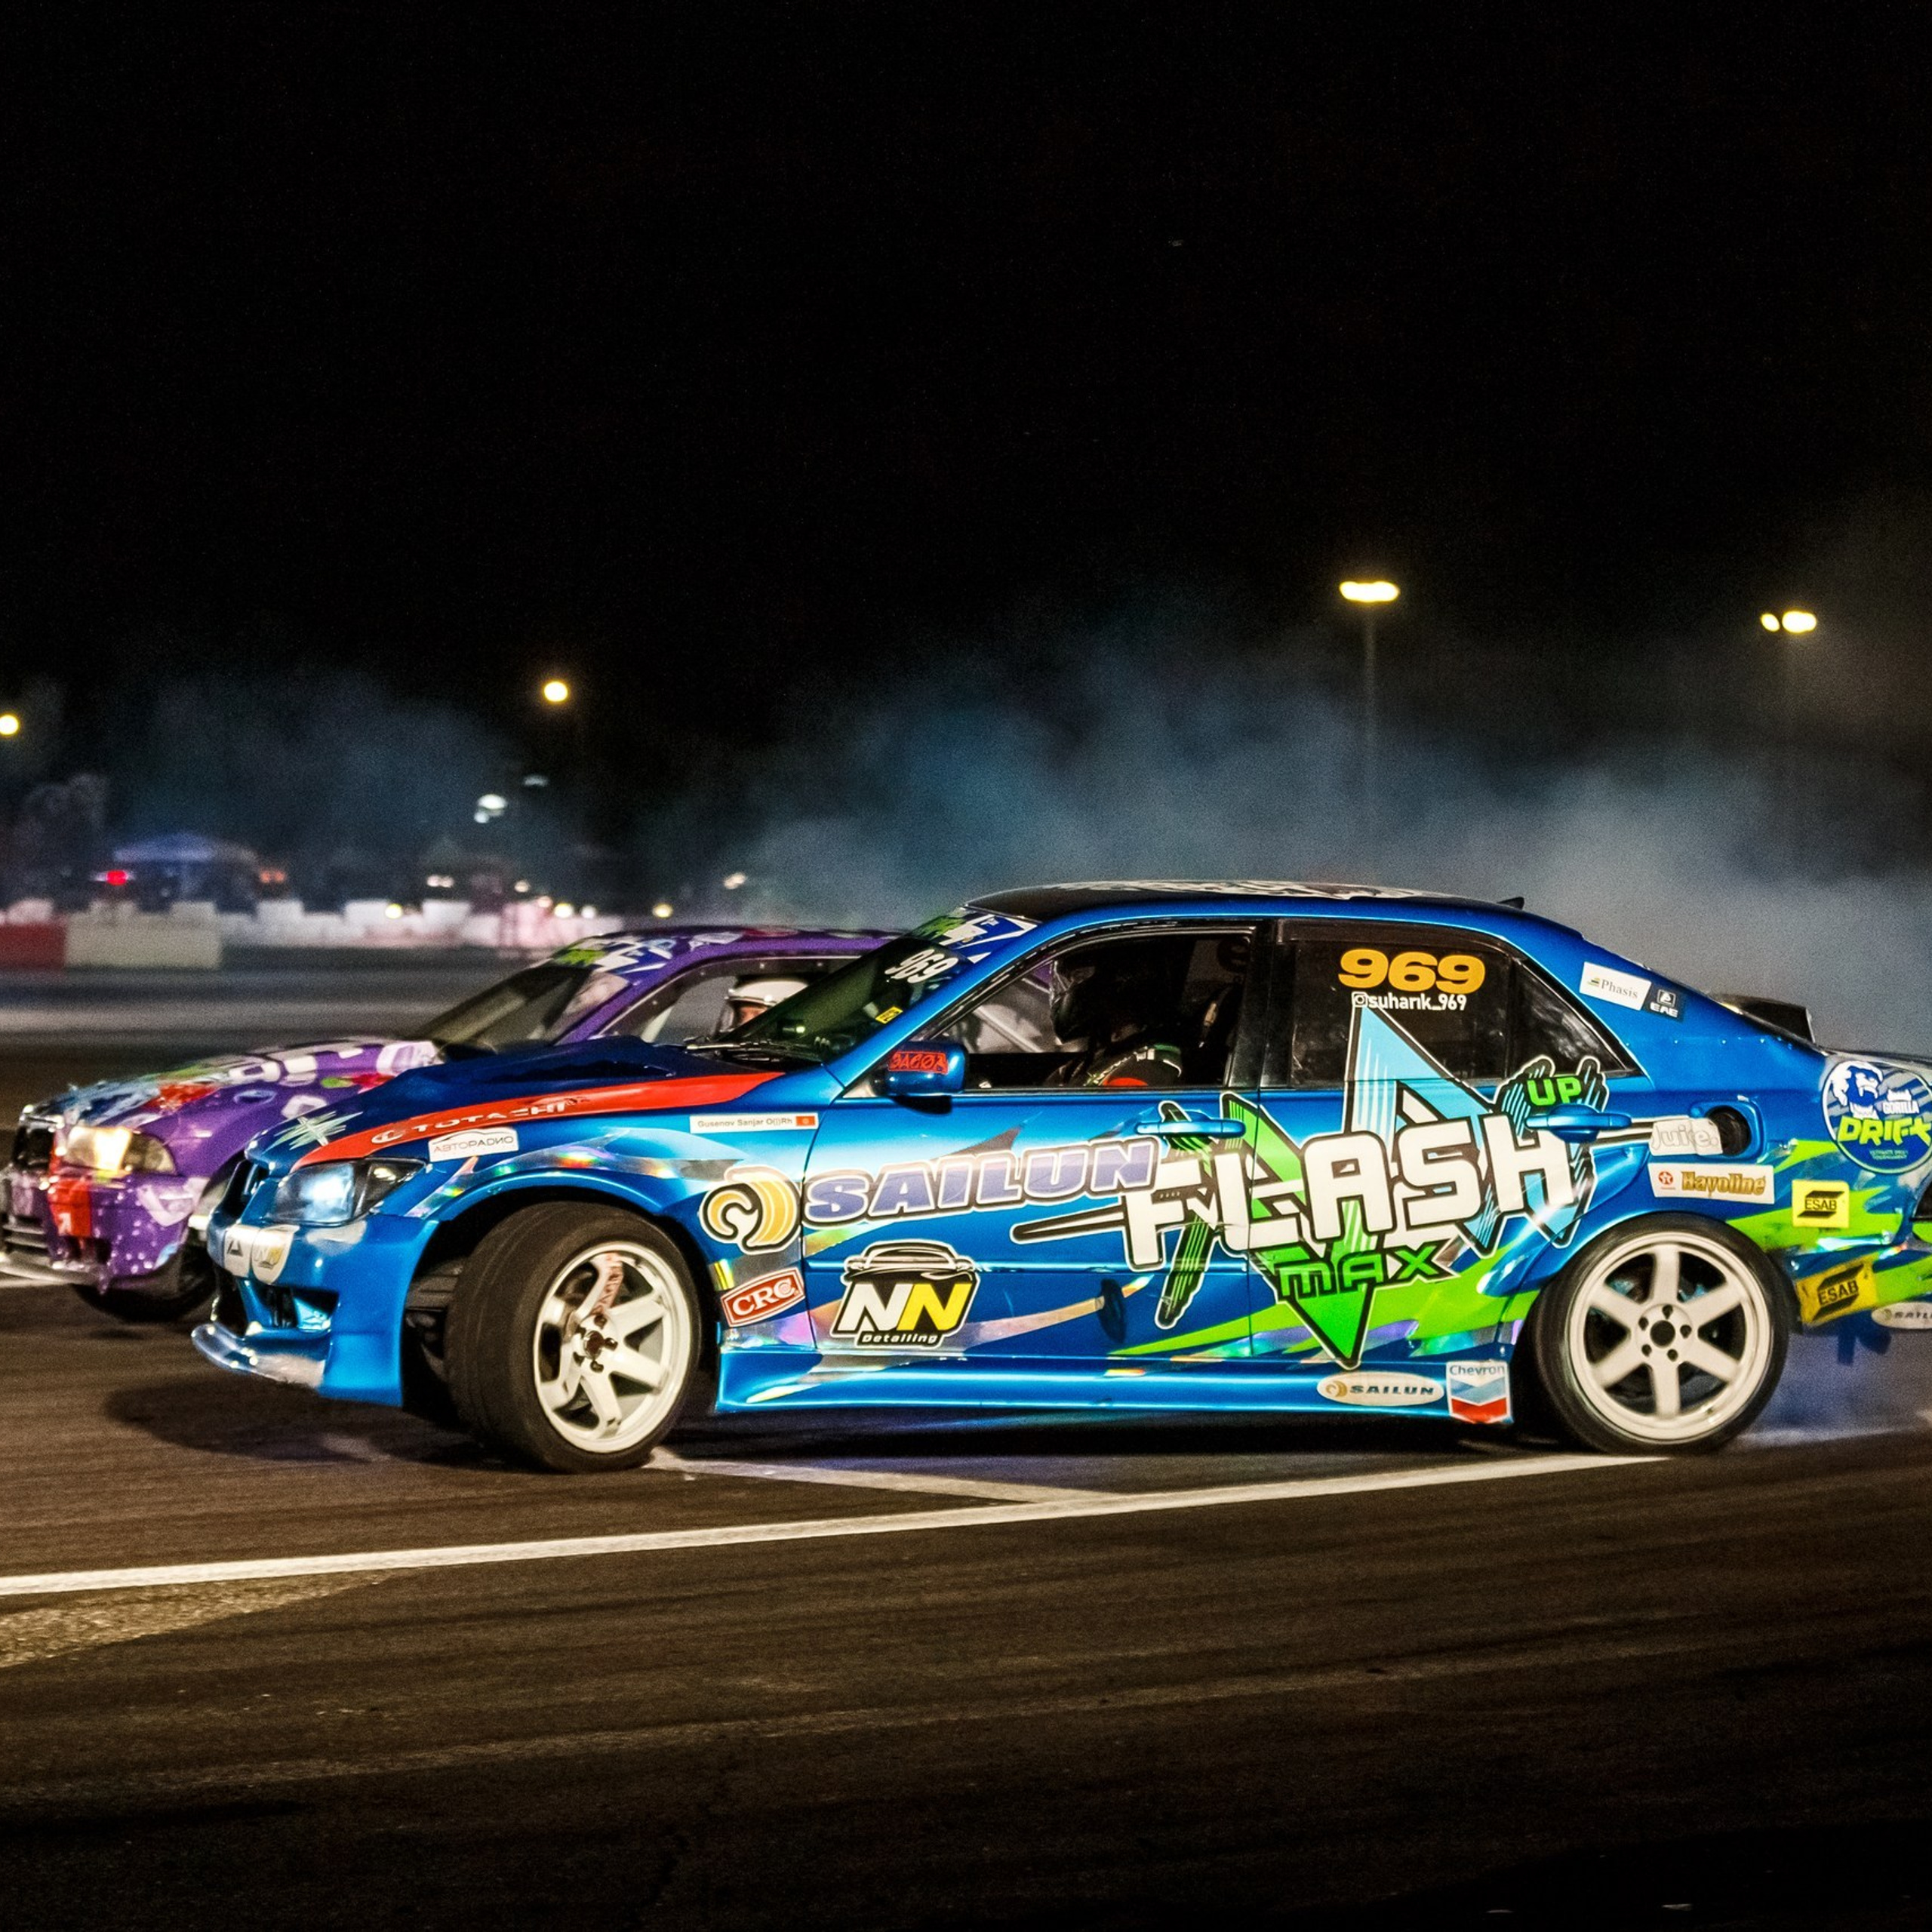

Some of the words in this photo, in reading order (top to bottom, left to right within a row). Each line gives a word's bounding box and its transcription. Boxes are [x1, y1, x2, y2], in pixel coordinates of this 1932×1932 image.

[1338, 949, 1485, 994] 969
[1601, 979, 1638, 998] Phasis
[1527, 1077, 1582, 1106] UP
[412, 1100, 568, 1132] TOTACHI
[1838, 1115, 1931, 1146] DRIFT
[804, 1140, 1158, 1222] SAILUN
[1123, 1115, 1574, 1266] FLASH
[1804, 1198, 1837, 1211] ESAB
[732, 1278, 796, 1316] CRC
[837, 1283, 973, 1331] NN
[1817, 1280, 1859, 1306] ESAB
[862, 1333, 938, 1344] Detailing
[1449, 1364, 1505, 1377] Chevron
[1349, 1385, 1434, 1395] SAILUN
